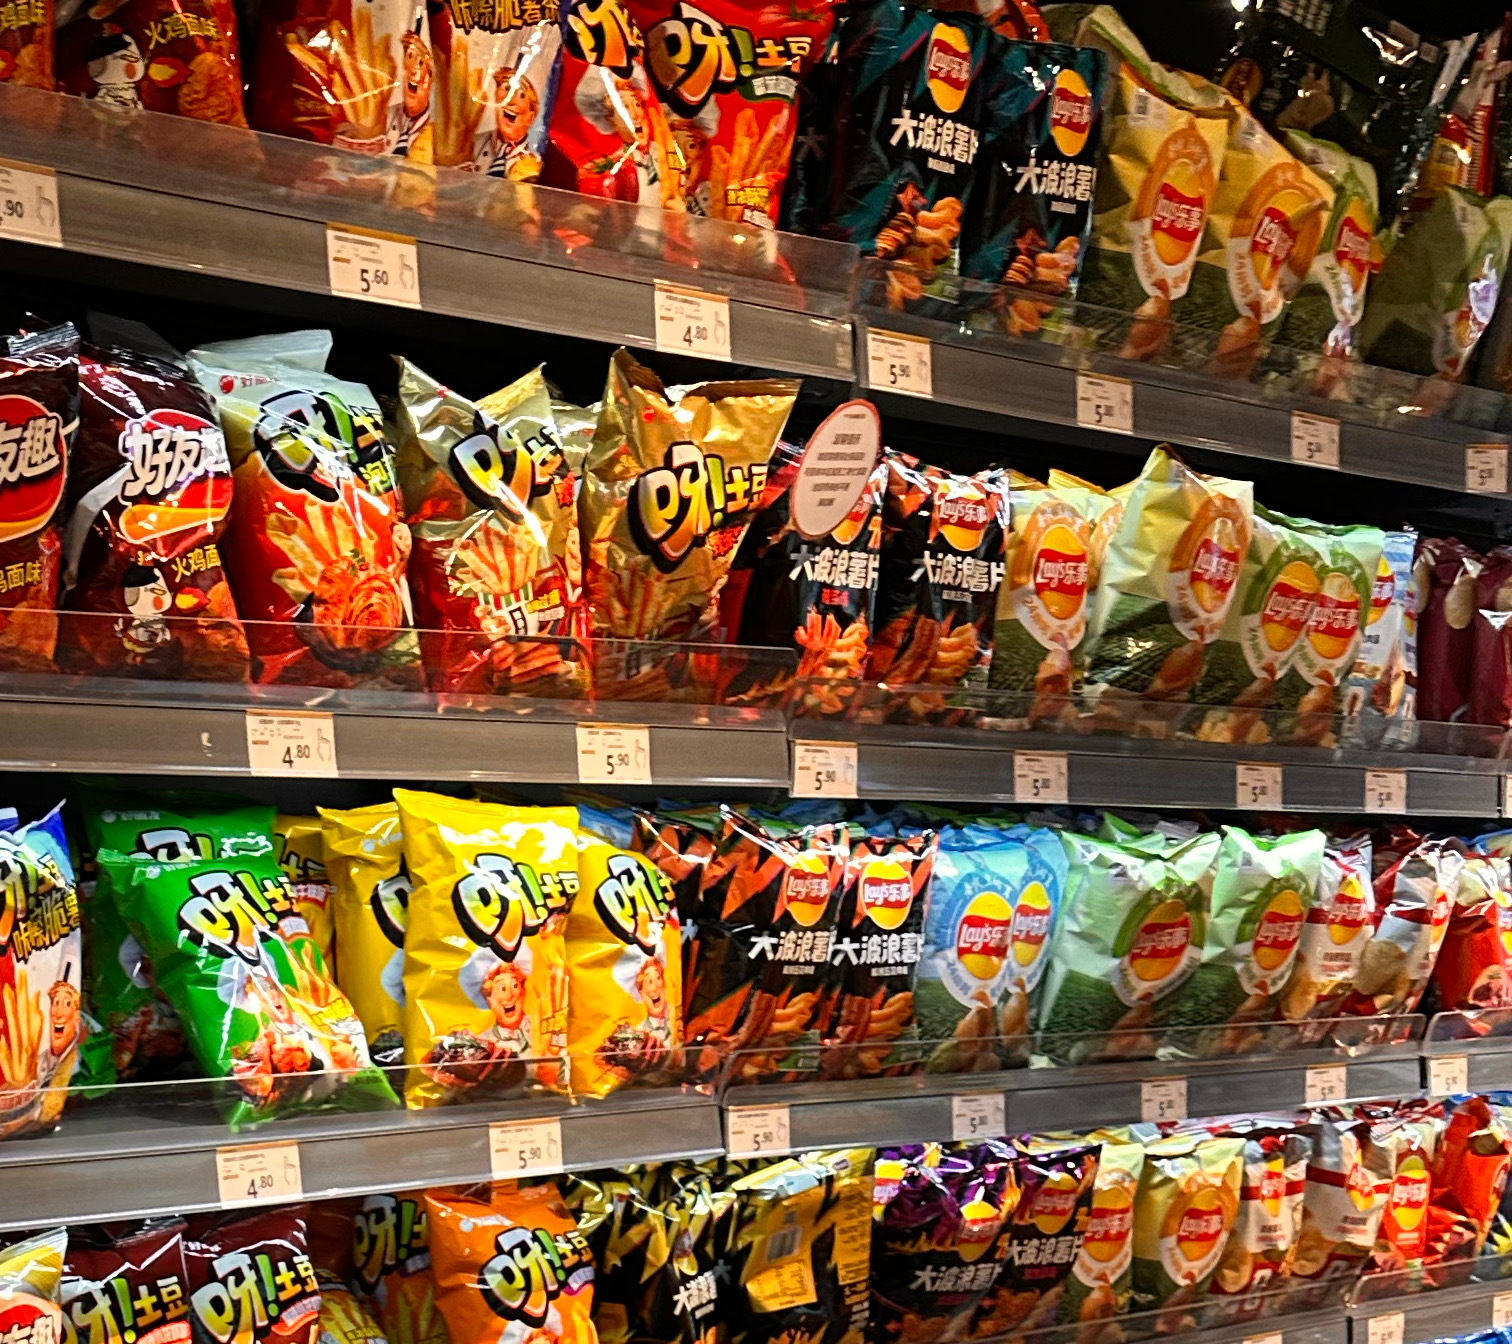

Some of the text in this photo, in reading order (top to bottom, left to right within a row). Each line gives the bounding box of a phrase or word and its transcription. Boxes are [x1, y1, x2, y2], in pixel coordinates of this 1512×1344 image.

[1014, 158, 1097, 202] 大波浪薯
[360, 267, 389, 292] 5.60
[122, 418, 230, 497] 好友趣
[629, 441, 769, 573] 呀!土豆
[170, 543, 222, 583] 火鸡面
[789, 545, 881, 592] 大波浪薯片
[910, 551, 1006, 593] 大波浪薯片
[281, 744, 311, 769] 4.80
[605, 754, 630, 776] 5.90
[453, 853, 580, 958] 呀!土豆
[518, 1146, 542, 1170] 5.90
[246, 1173, 275, 1198] 4.80
[480, 1225, 594, 1318] 呀!土豆
